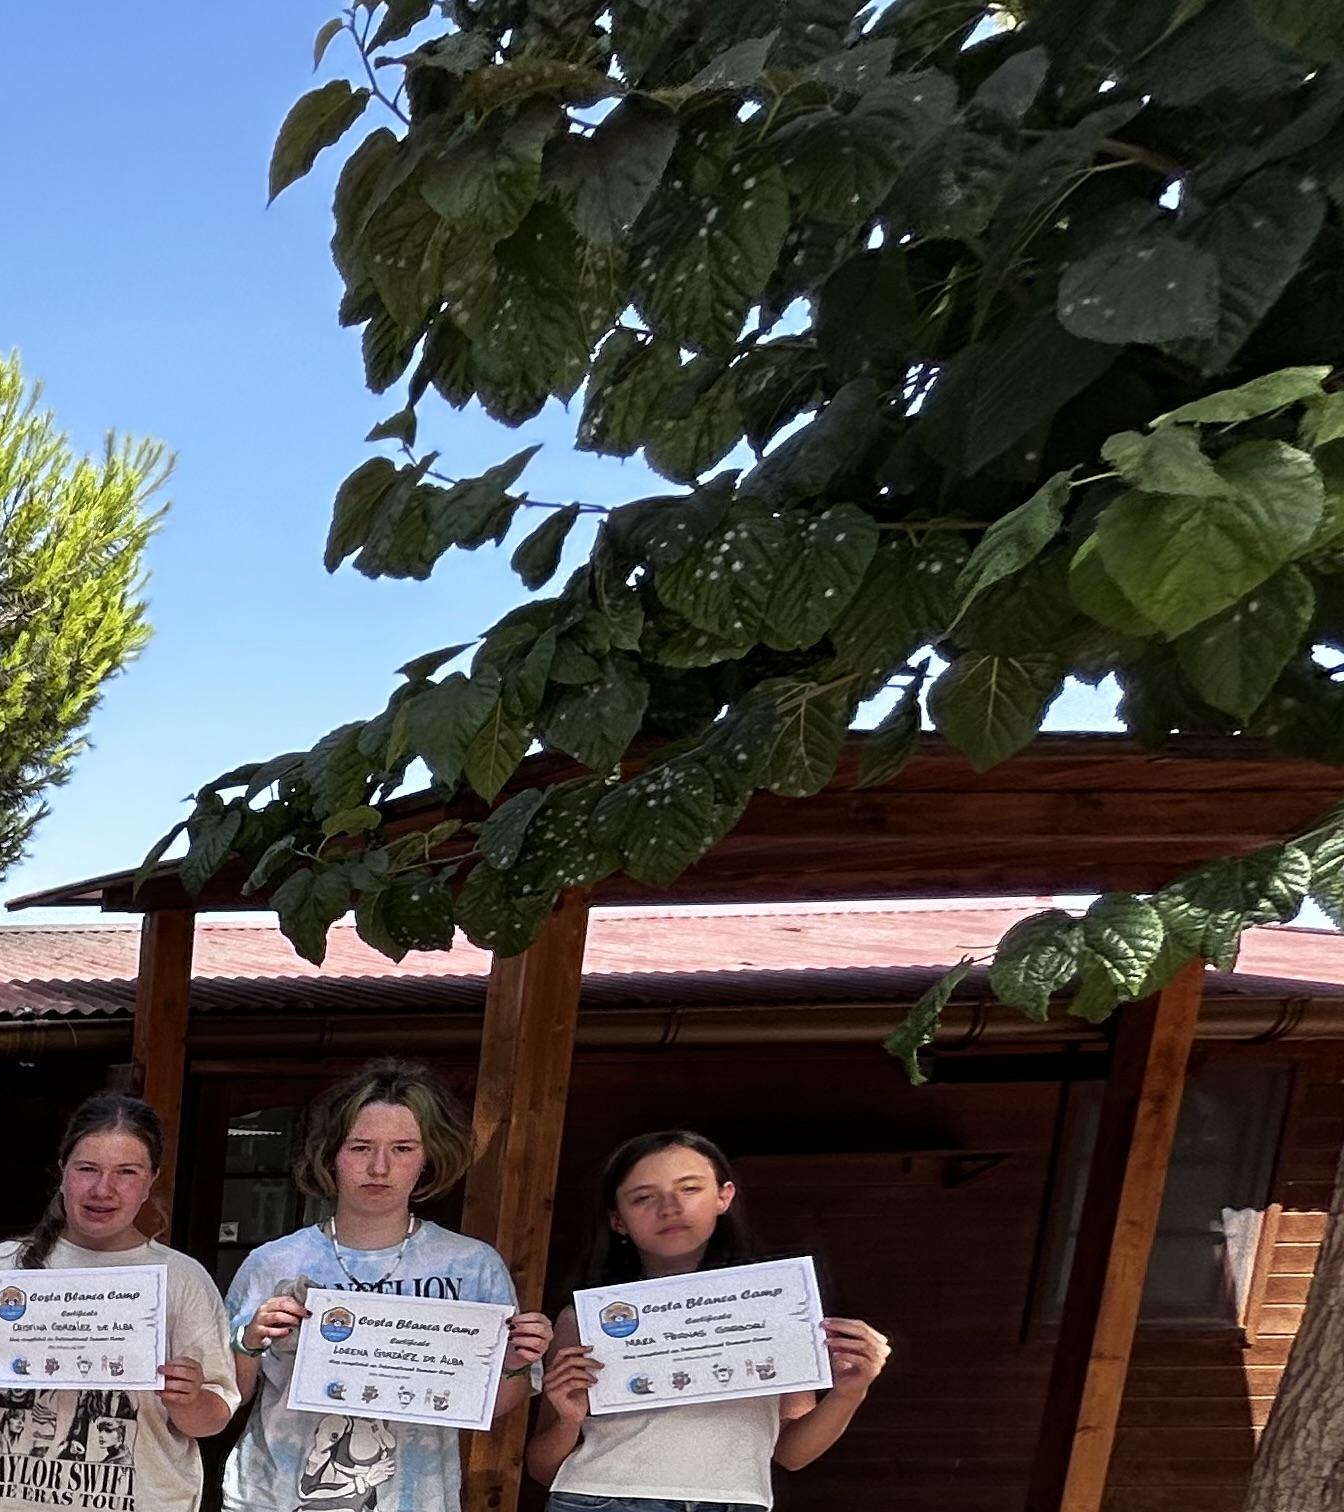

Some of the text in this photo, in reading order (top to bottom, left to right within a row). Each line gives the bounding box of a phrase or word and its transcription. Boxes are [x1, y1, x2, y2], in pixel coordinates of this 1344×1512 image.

[30, 1291, 140, 1302] Costa Blanca Camp
[642, 1287, 783, 1315] Costa Blanca Camp
[112, 1322, 134, 1331] ALBA
[358, 1316, 480, 1336] Costa Blanca Camp
[333, 1345, 369, 1357] LORENA
[422, 1355, 435, 1363] DE
[439, 1355, 464, 1366] ALBA
[68, 1462, 136, 1497] SWIFT
[21, 1489, 74, 1506] ERAS
[79, 1493, 135, 1512] TOUR
